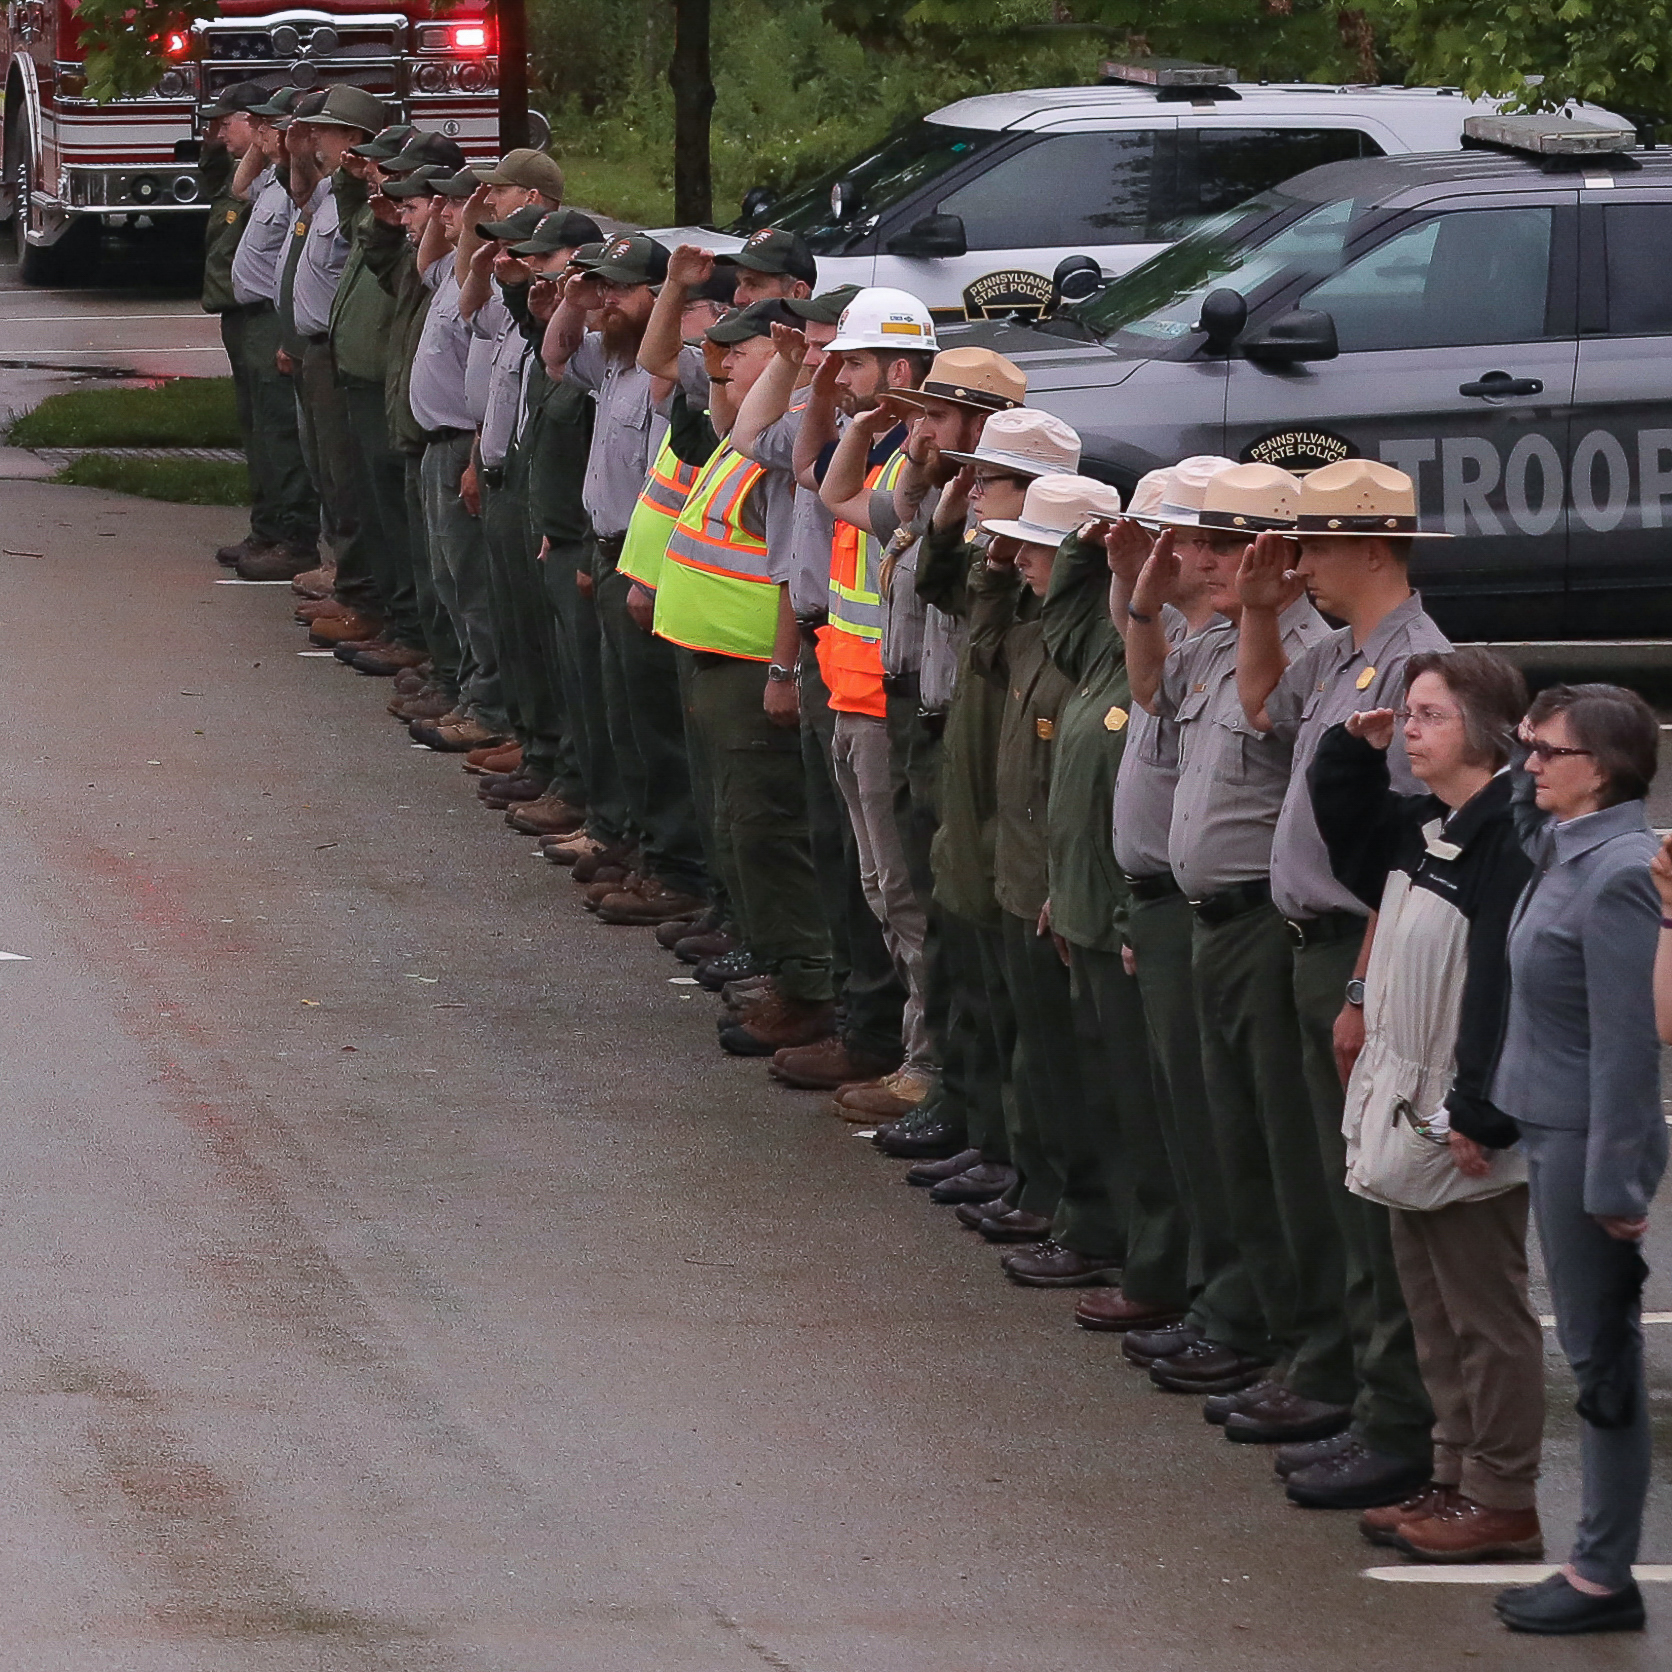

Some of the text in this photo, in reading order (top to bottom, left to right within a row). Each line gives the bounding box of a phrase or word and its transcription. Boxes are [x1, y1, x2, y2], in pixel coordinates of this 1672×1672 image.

[969, 273, 1053, 297] PENNSYLVANIA
[974, 283, 1052, 306] STATE POLICE
[1250, 432, 1348, 460] PENNSYLVANIA
[1257, 445, 1296, 464] TATE
